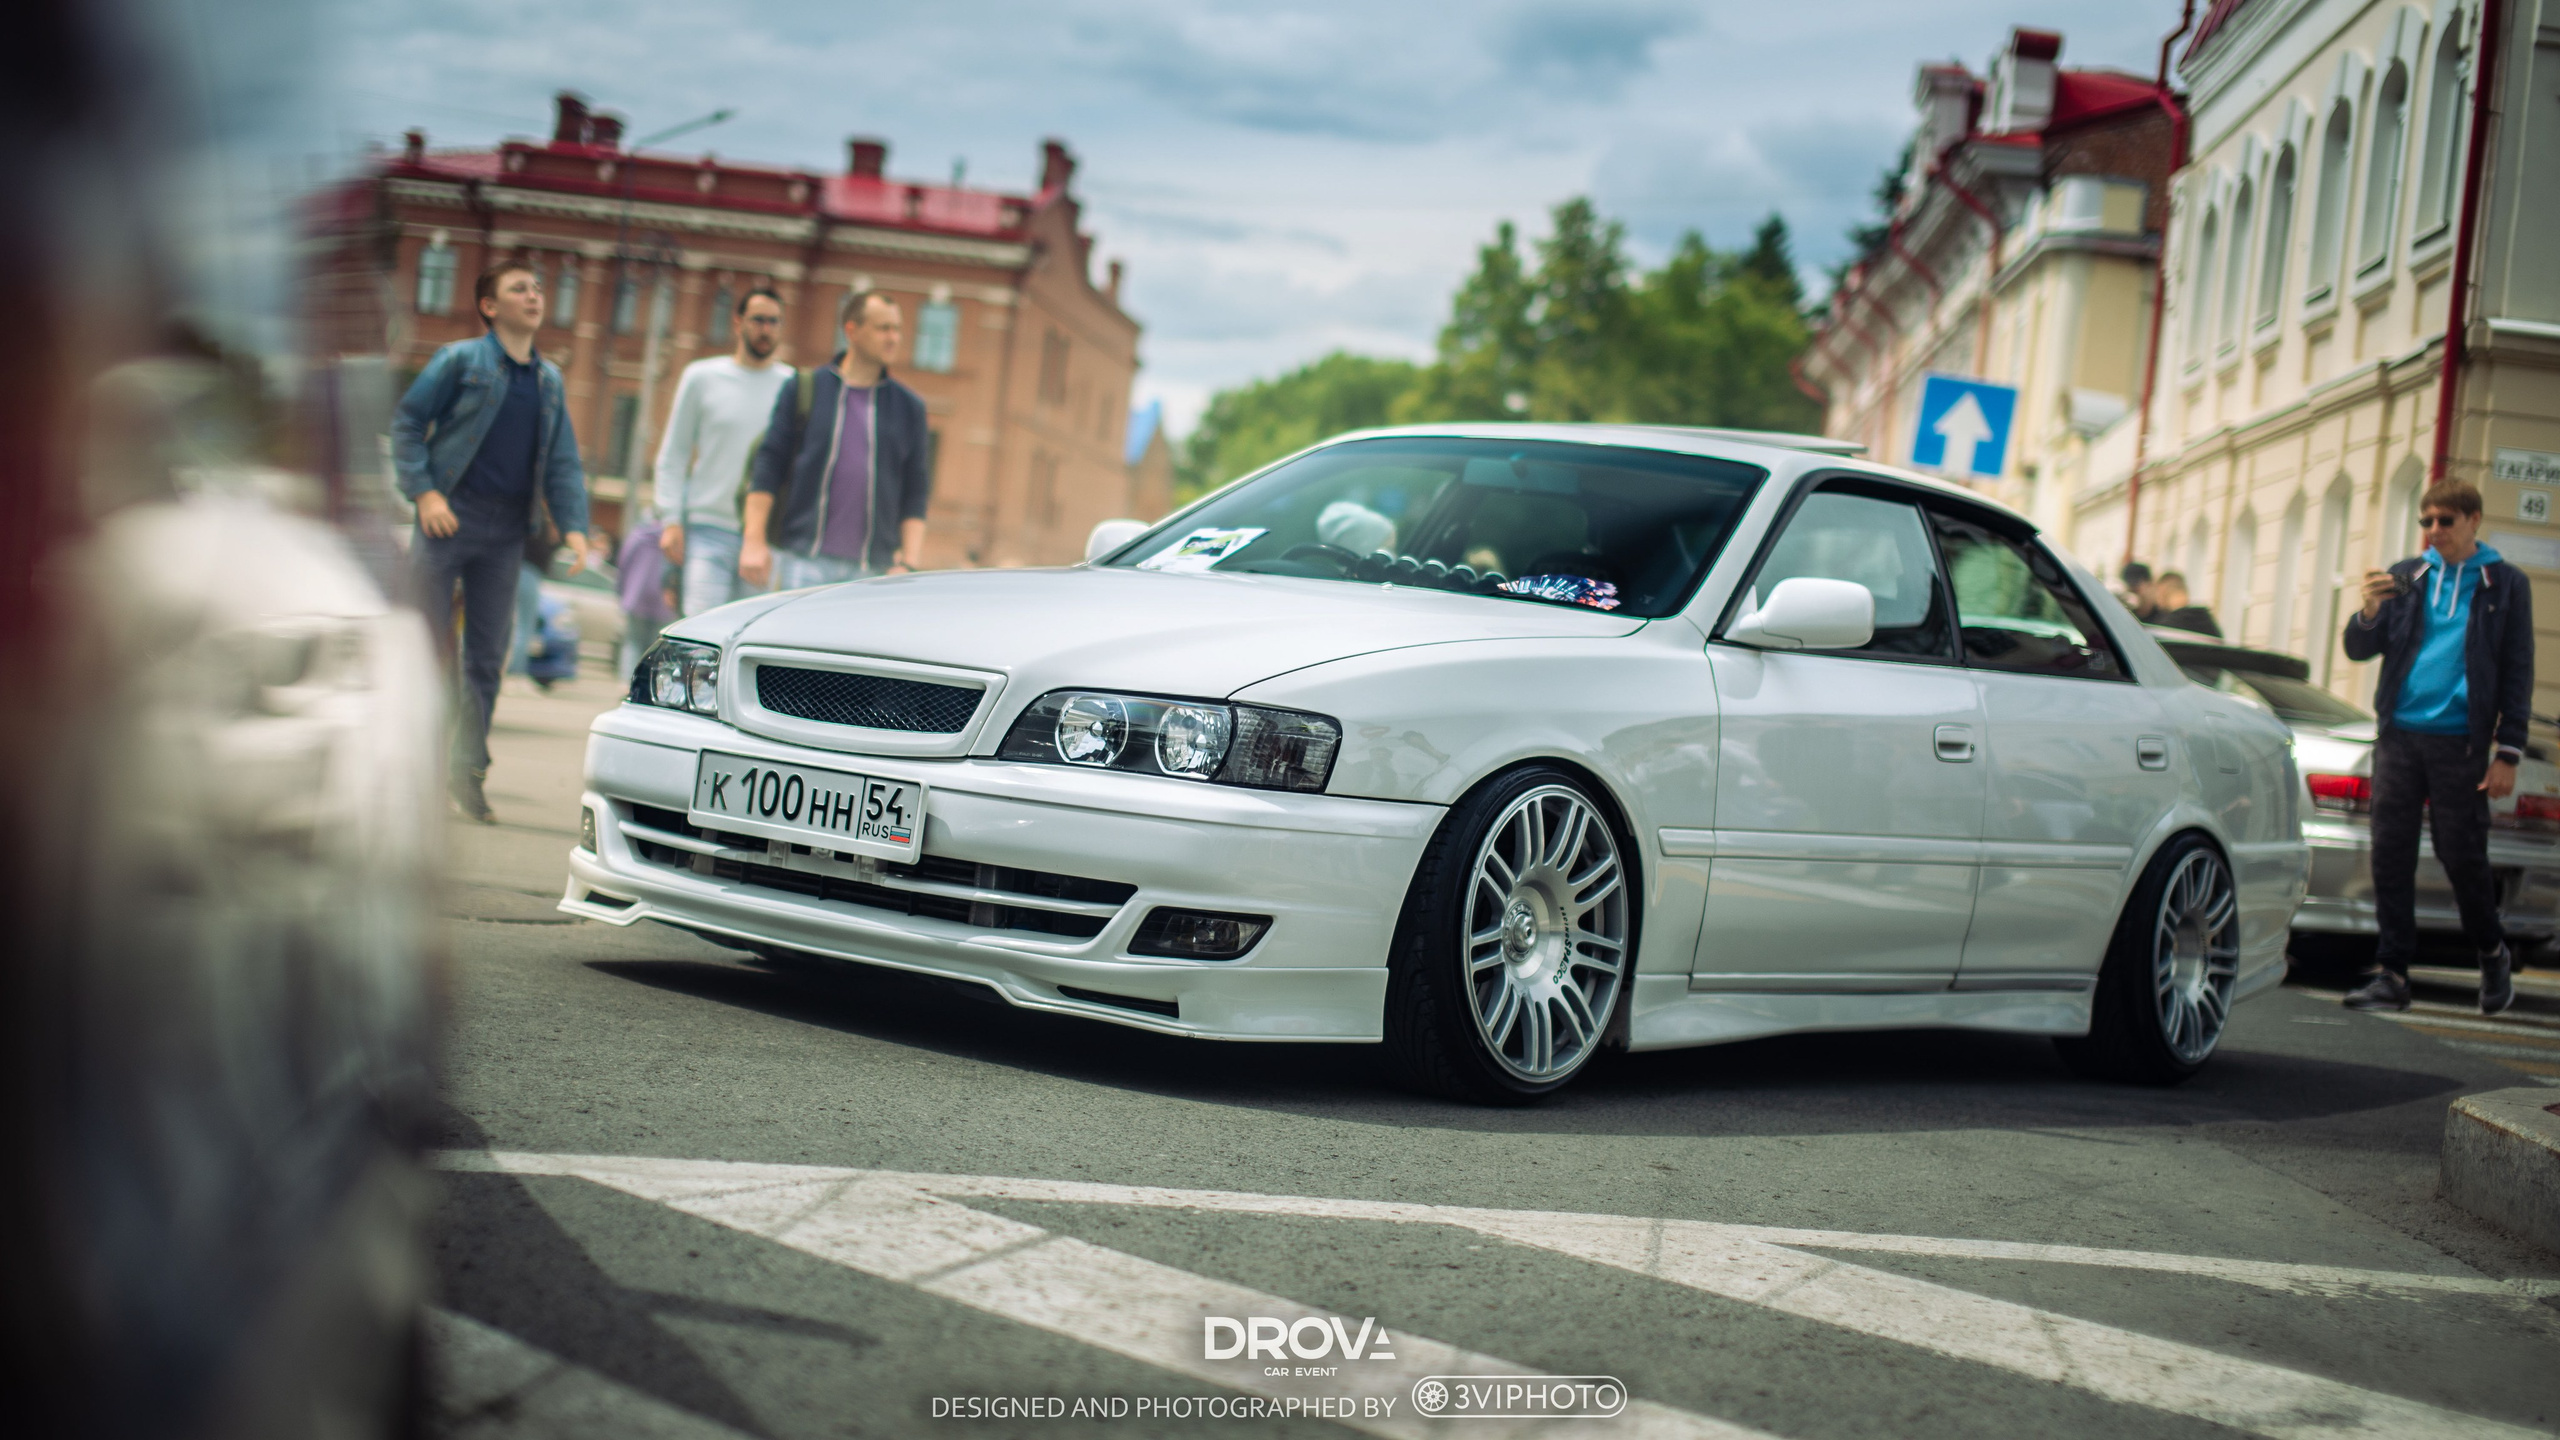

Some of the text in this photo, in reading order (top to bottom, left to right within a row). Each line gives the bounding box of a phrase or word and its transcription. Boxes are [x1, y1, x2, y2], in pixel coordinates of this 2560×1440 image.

[2523, 496, 2545, 516] 49
[865, 782, 904, 826] 54
[861, 822, 889, 840] RUS
[1552, 939, 1573, 985] SPARCO
